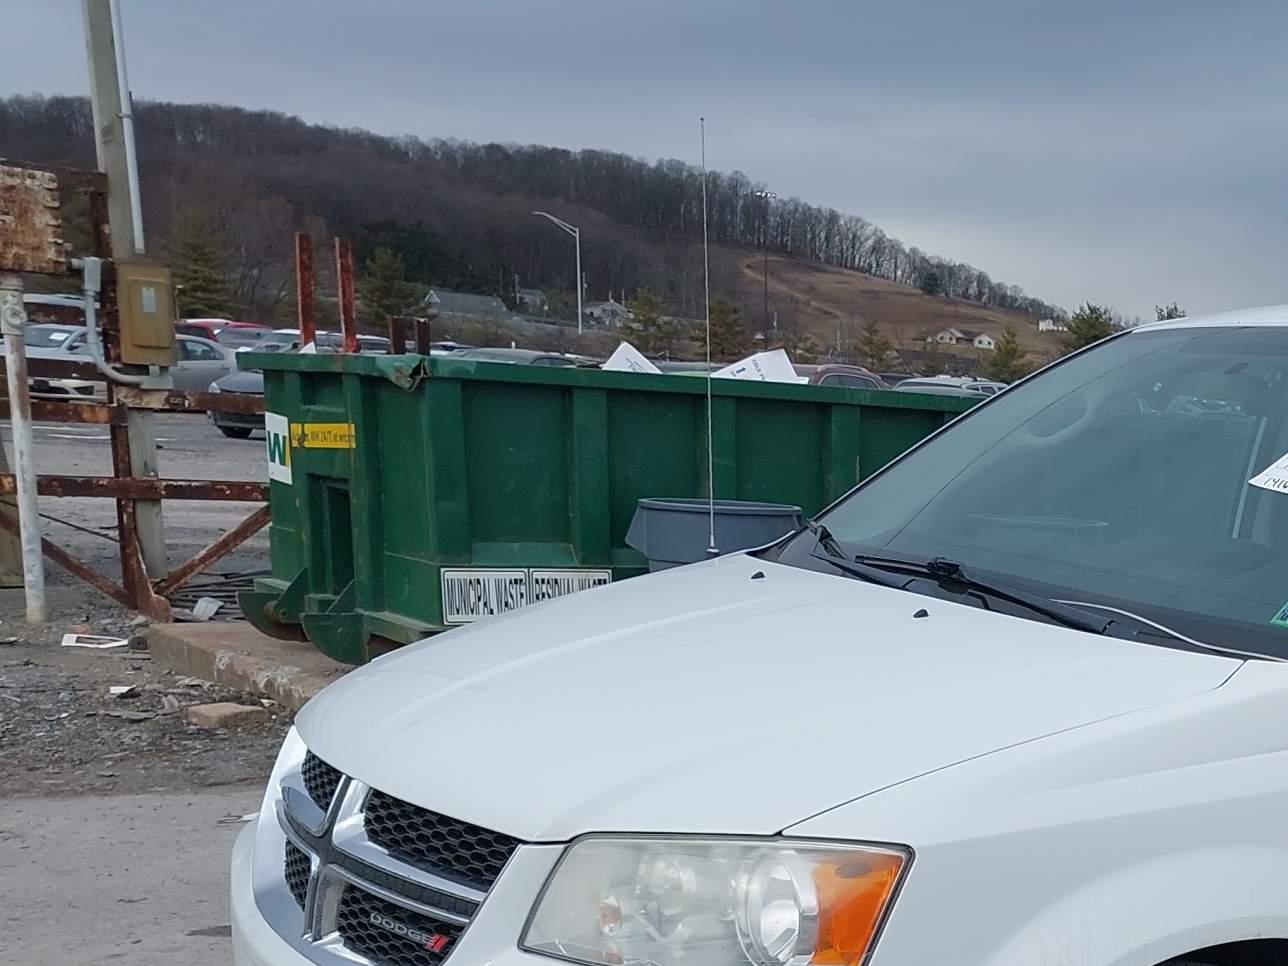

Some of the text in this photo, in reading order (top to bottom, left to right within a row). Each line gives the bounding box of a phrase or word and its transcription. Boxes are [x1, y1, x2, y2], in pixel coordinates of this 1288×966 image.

[446, 577, 526, 616] MUNICIPAL WASTE
[368, 911, 434, 949] DODGE
